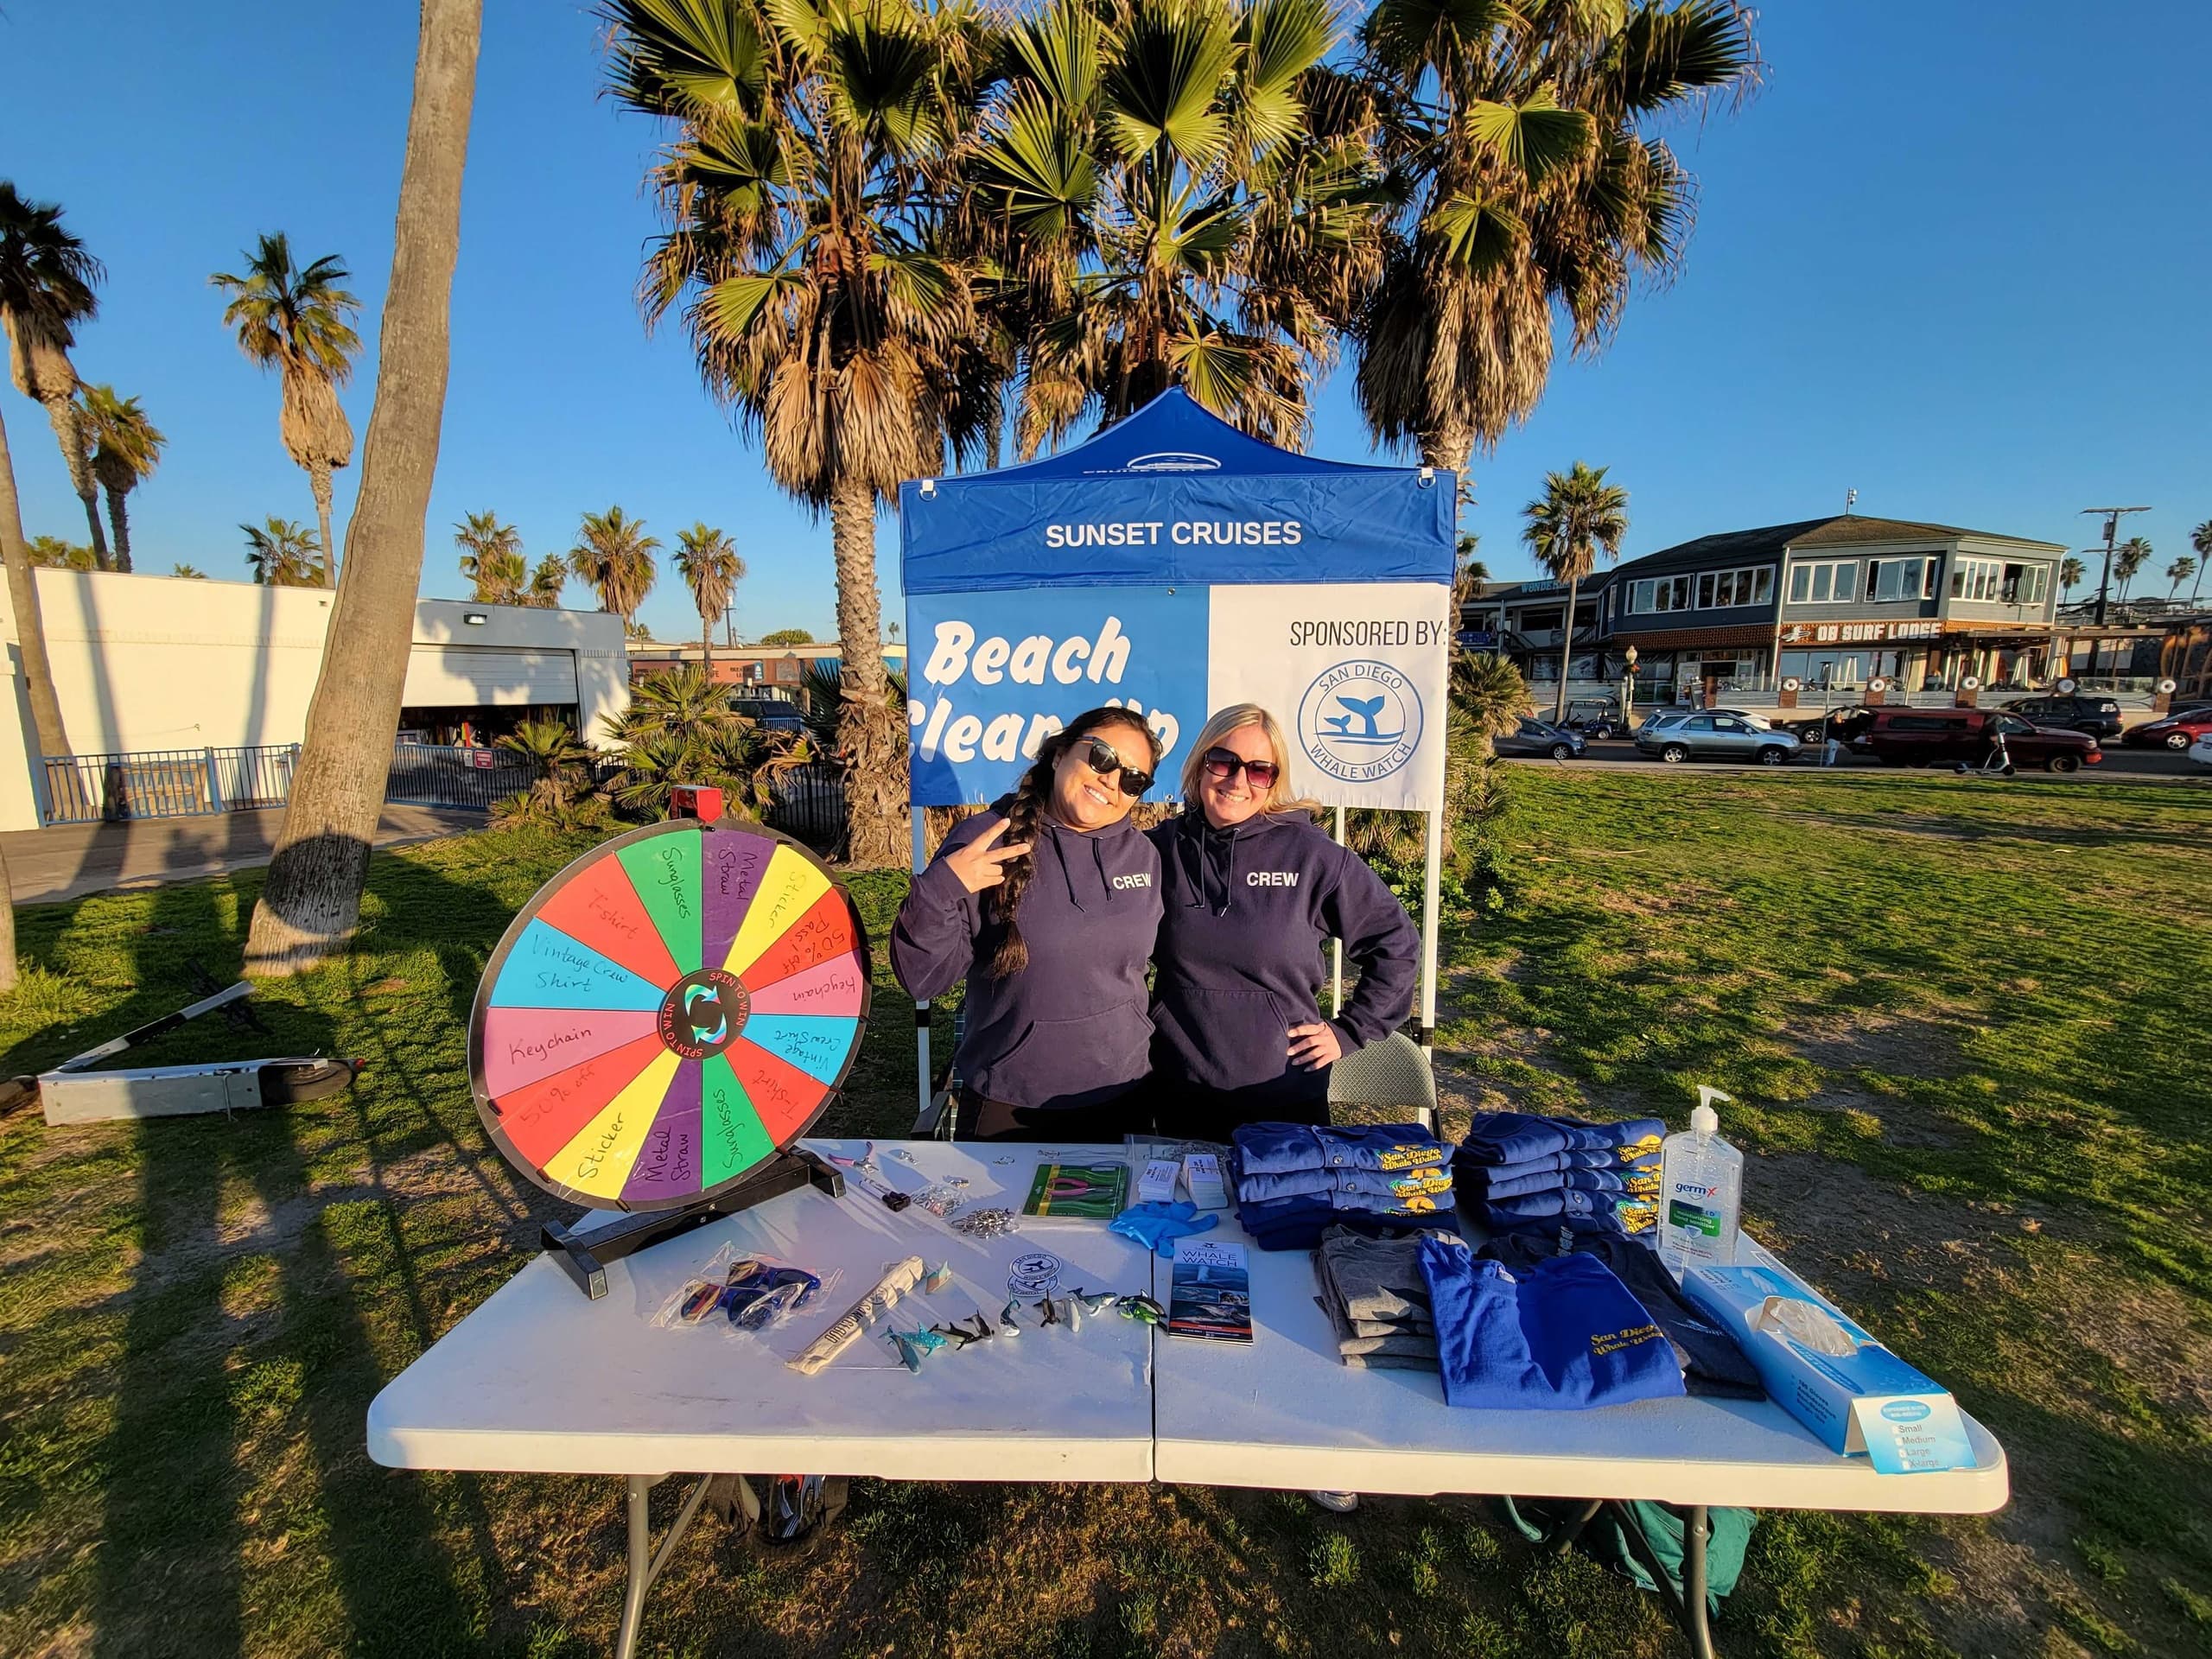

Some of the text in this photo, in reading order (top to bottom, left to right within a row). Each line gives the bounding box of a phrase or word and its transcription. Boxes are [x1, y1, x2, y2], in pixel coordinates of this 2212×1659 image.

[1046, 520, 1302, 548] SUNSET CRUISES
[1290, 620, 1448, 646] SPONSORED BY:
[1817, 621, 1942, 641] OB SURF LODGE
[923, 615, 1131, 685] Beach
[1319, 664, 1403, 692] SAN DIEGO
[1309, 741, 1412, 779] WHALE WATCH
[657, 847, 691, 919] Sunglasses
[717, 849, 737, 895] Straw
[735, 851, 759, 901] Metal
[1112, 873, 1152, 890] CREW
[1246, 872, 1300, 887] CREW
[588, 887, 639, 940] T-shirt
[767, 871, 807, 929] Sticker
[532, 933, 629, 983] Vintage Crew
[804, 927, 846, 963] 50%
[535, 970, 593, 993] Shirt
[792, 973, 856, 1002] Keychain
[709, 971, 748, 1027] SPIN TO WIN
[662, 1002, 704, 1058] SPIN TO WIN
[774, 1029, 842, 1052] Crew Shirt
[508, 1027, 593, 1065] Keychain
[784, 1043, 830, 1071] Vintage
[519, 1063, 595, 1128] 50% off
[752, 1069, 800, 1121] T-shirt
[713, 1089, 746, 1169] Sunglasses
[577, 1111, 625, 1179] Sticker
[645, 1126, 671, 1182] Metal
[671, 1133, 691, 1181] Straw
[1383, 1147, 1441, 1164] San Diego
[1382, 1154, 1443, 1171] Whale Watch
[1399, 1184, 1421, 1193] San
[1629, 1177, 1652, 1188] San
[1182, 1250, 1237, 1261] WHALE
[1182, 1256, 1237, 1268] WATCH
[1590, 1333, 1618, 1346] San
[1898, 1424, 1923, 1433] Small
[1902, 1435, 1936, 1446] Medium
